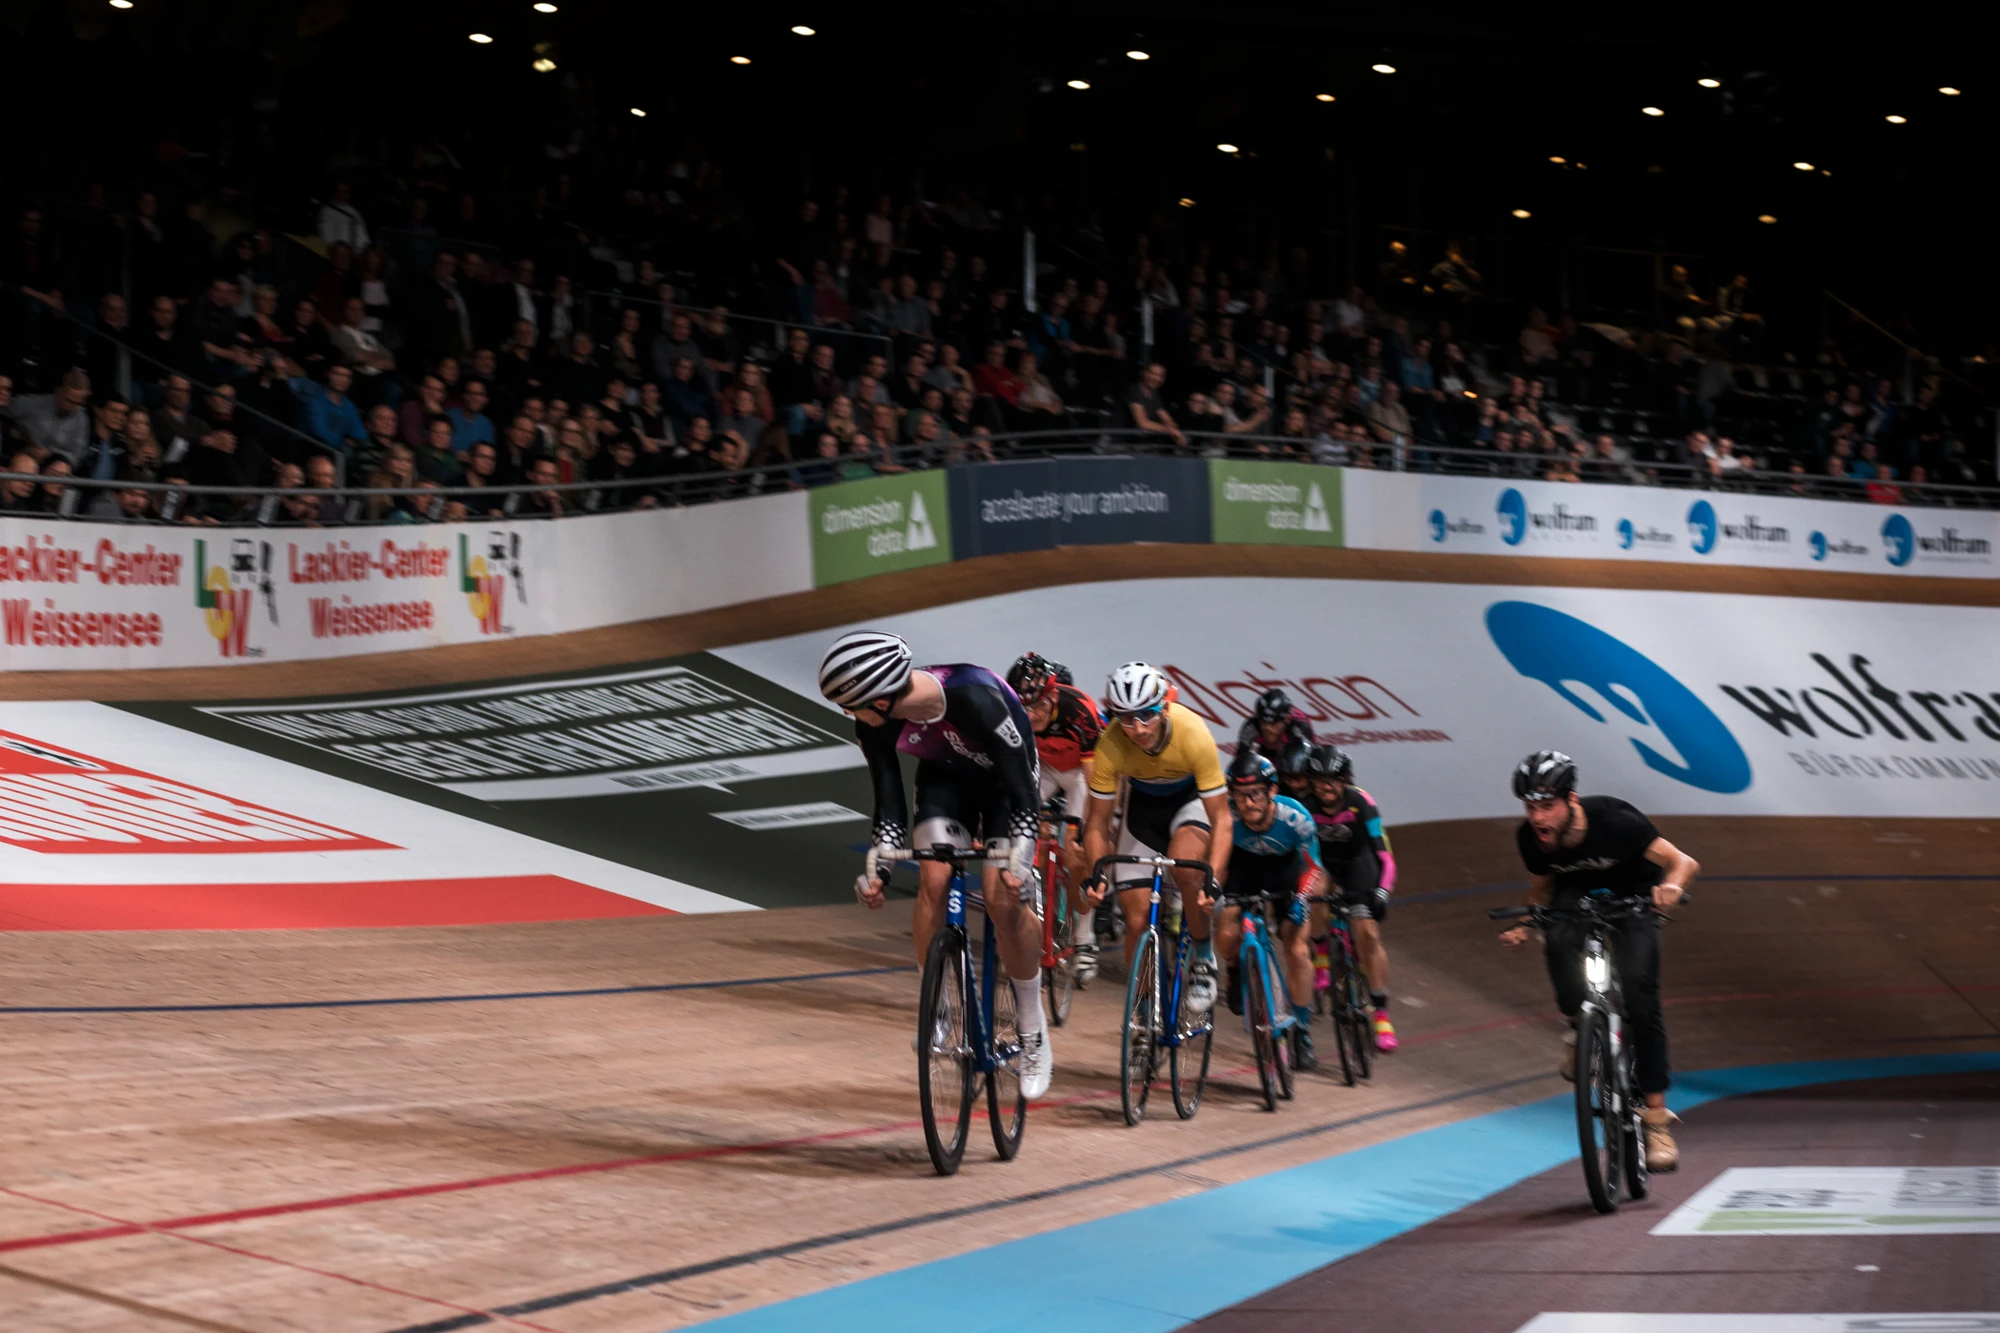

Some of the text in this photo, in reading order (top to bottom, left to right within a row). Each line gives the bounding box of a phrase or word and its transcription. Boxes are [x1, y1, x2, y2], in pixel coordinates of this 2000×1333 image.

[1528, 502, 1598, 532] wolfram
[1720, 514, 1790, 543] wolfram
[288, 538, 449, 584] Lackier-Center
[1917, 527, 1992, 555] wolfram
[2, 597, 164, 647] Weissensee
[308, 594, 434, 639] Weissensee
[1717, 651, 2000, 742] wolfra
[331, 742, 537, 779] GEGEN
